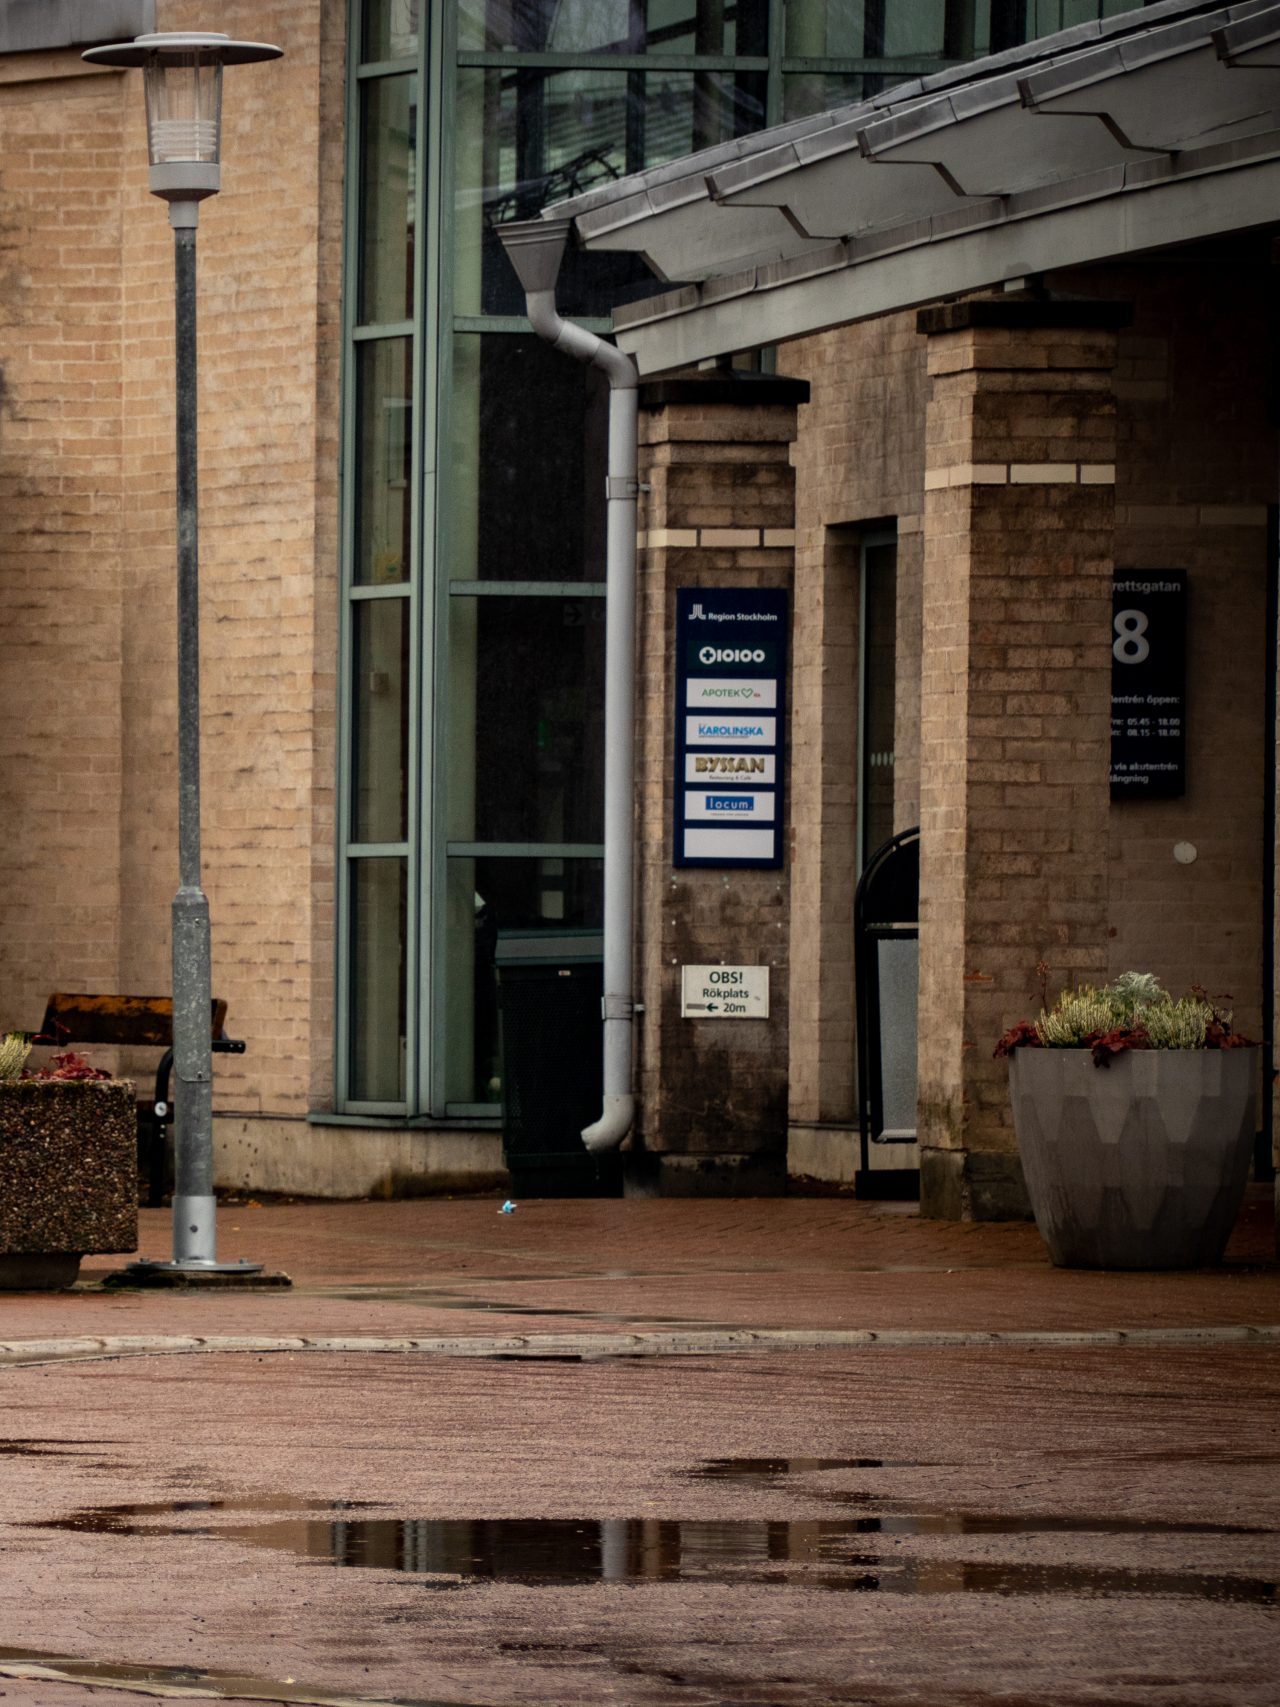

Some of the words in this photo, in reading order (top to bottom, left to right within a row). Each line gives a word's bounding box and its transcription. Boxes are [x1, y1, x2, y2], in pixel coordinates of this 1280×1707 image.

[1112, 580, 1181, 595] rettsgatan
[708, 612, 736, 622] Region
[736, 613, 778, 622] Stockholm
[1112, 608, 1150, 665] 8
[701, 688, 740, 698] APOTEK
[1111, 694, 1145, 704] entrén
[698, 725, 764, 736] KAROLINSKA
[695, 757, 765, 773] BYSSAN
[709, 971, 743, 984] OBS!
[702, 988, 749, 1000] Rökplats
[723, 1003, 746, 1013] 20m
